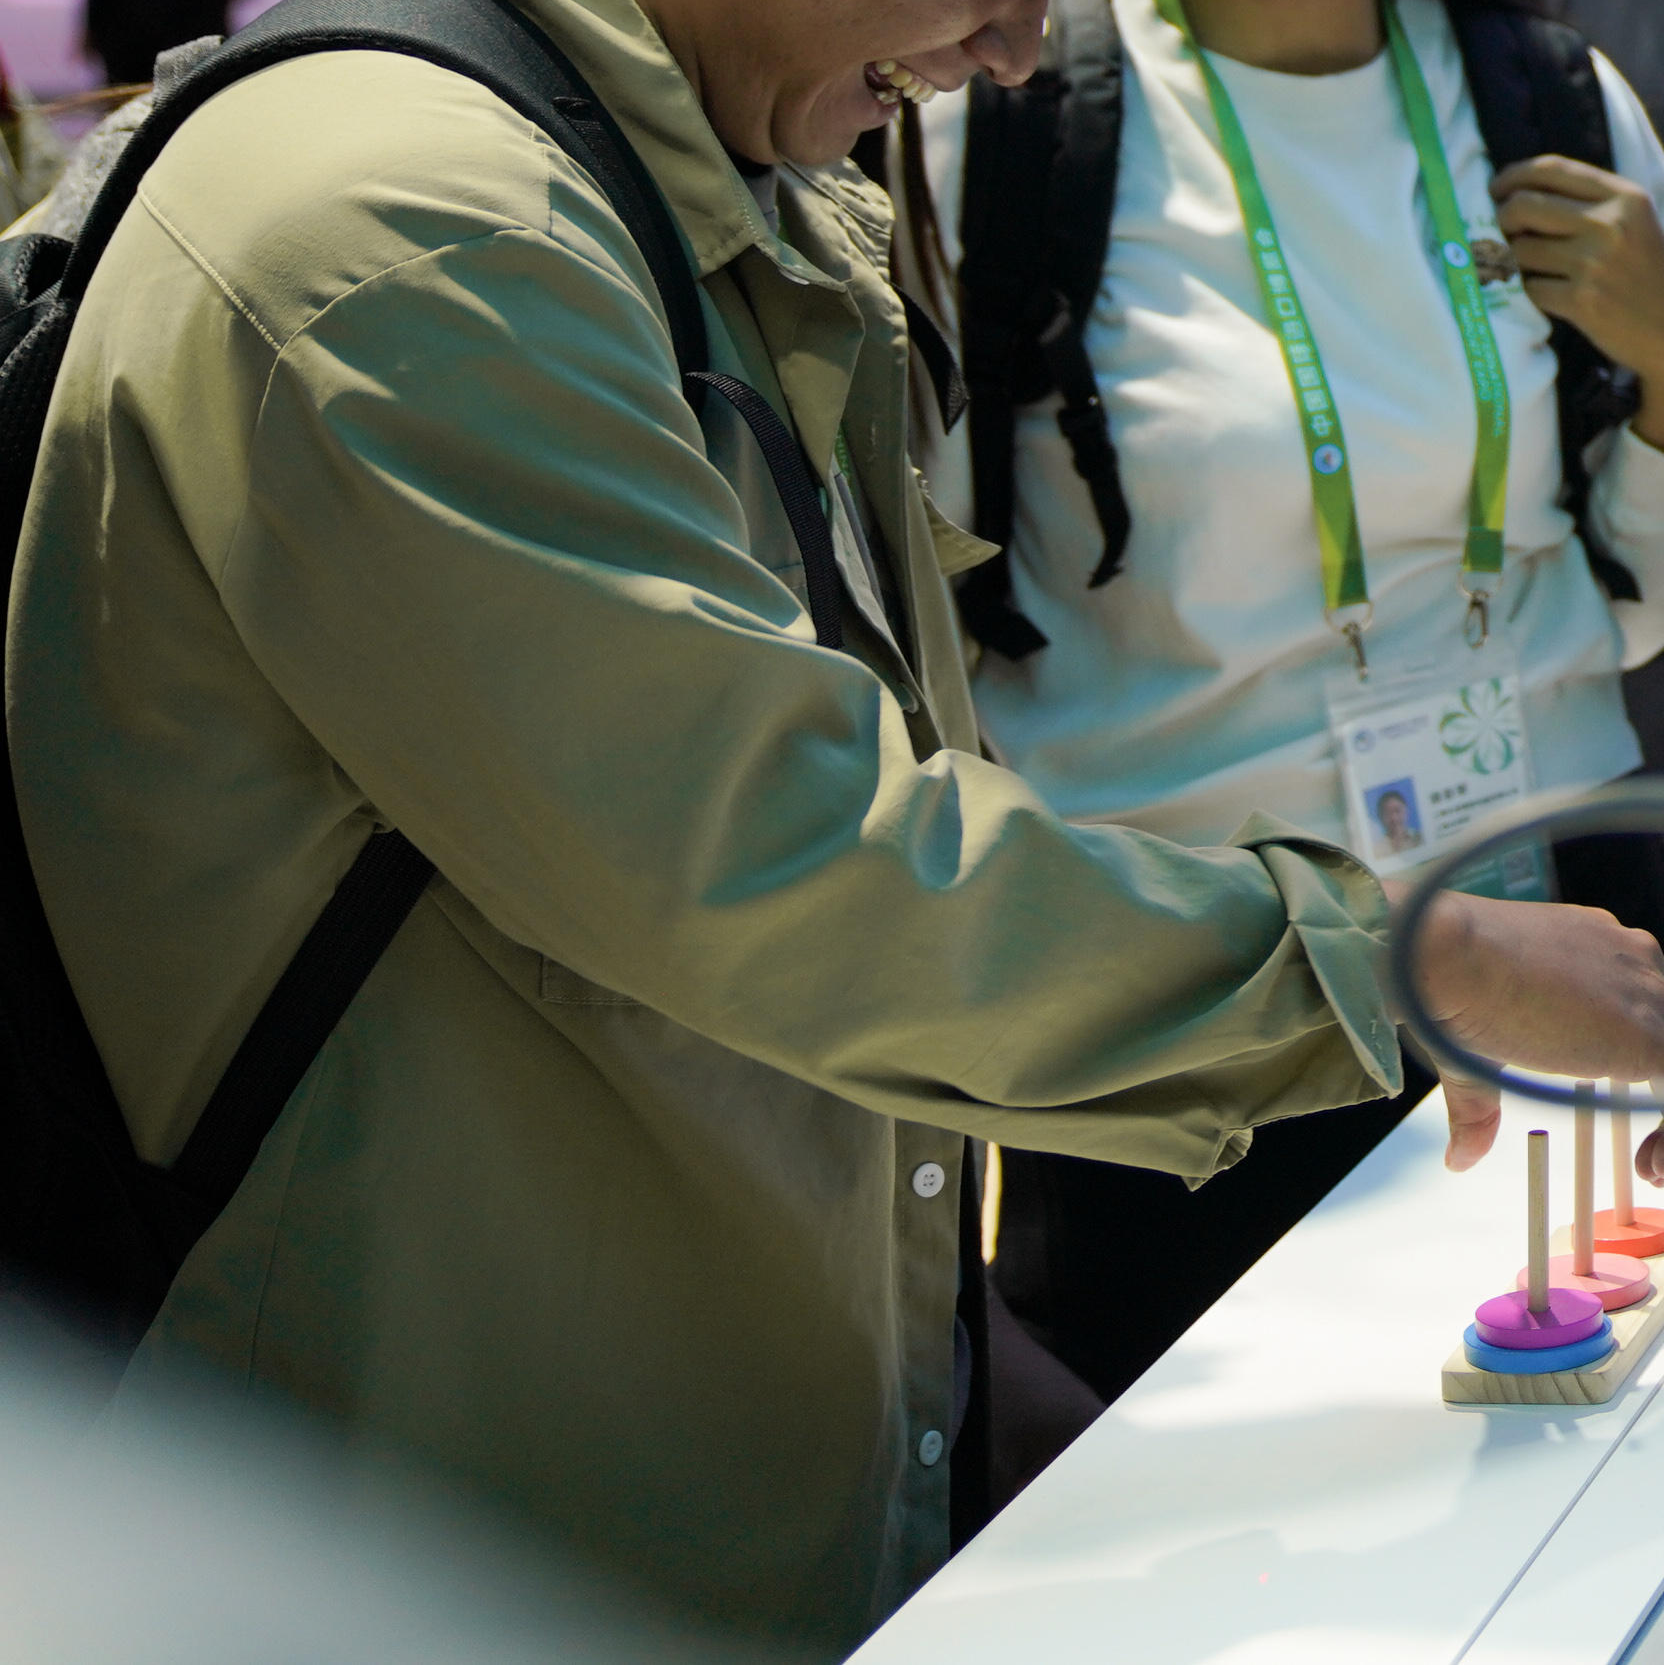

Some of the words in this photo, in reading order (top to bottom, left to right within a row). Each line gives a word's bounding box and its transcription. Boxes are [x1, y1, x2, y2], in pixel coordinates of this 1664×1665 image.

[1254, 226, 1334, 438] 中国国际进口博览会
